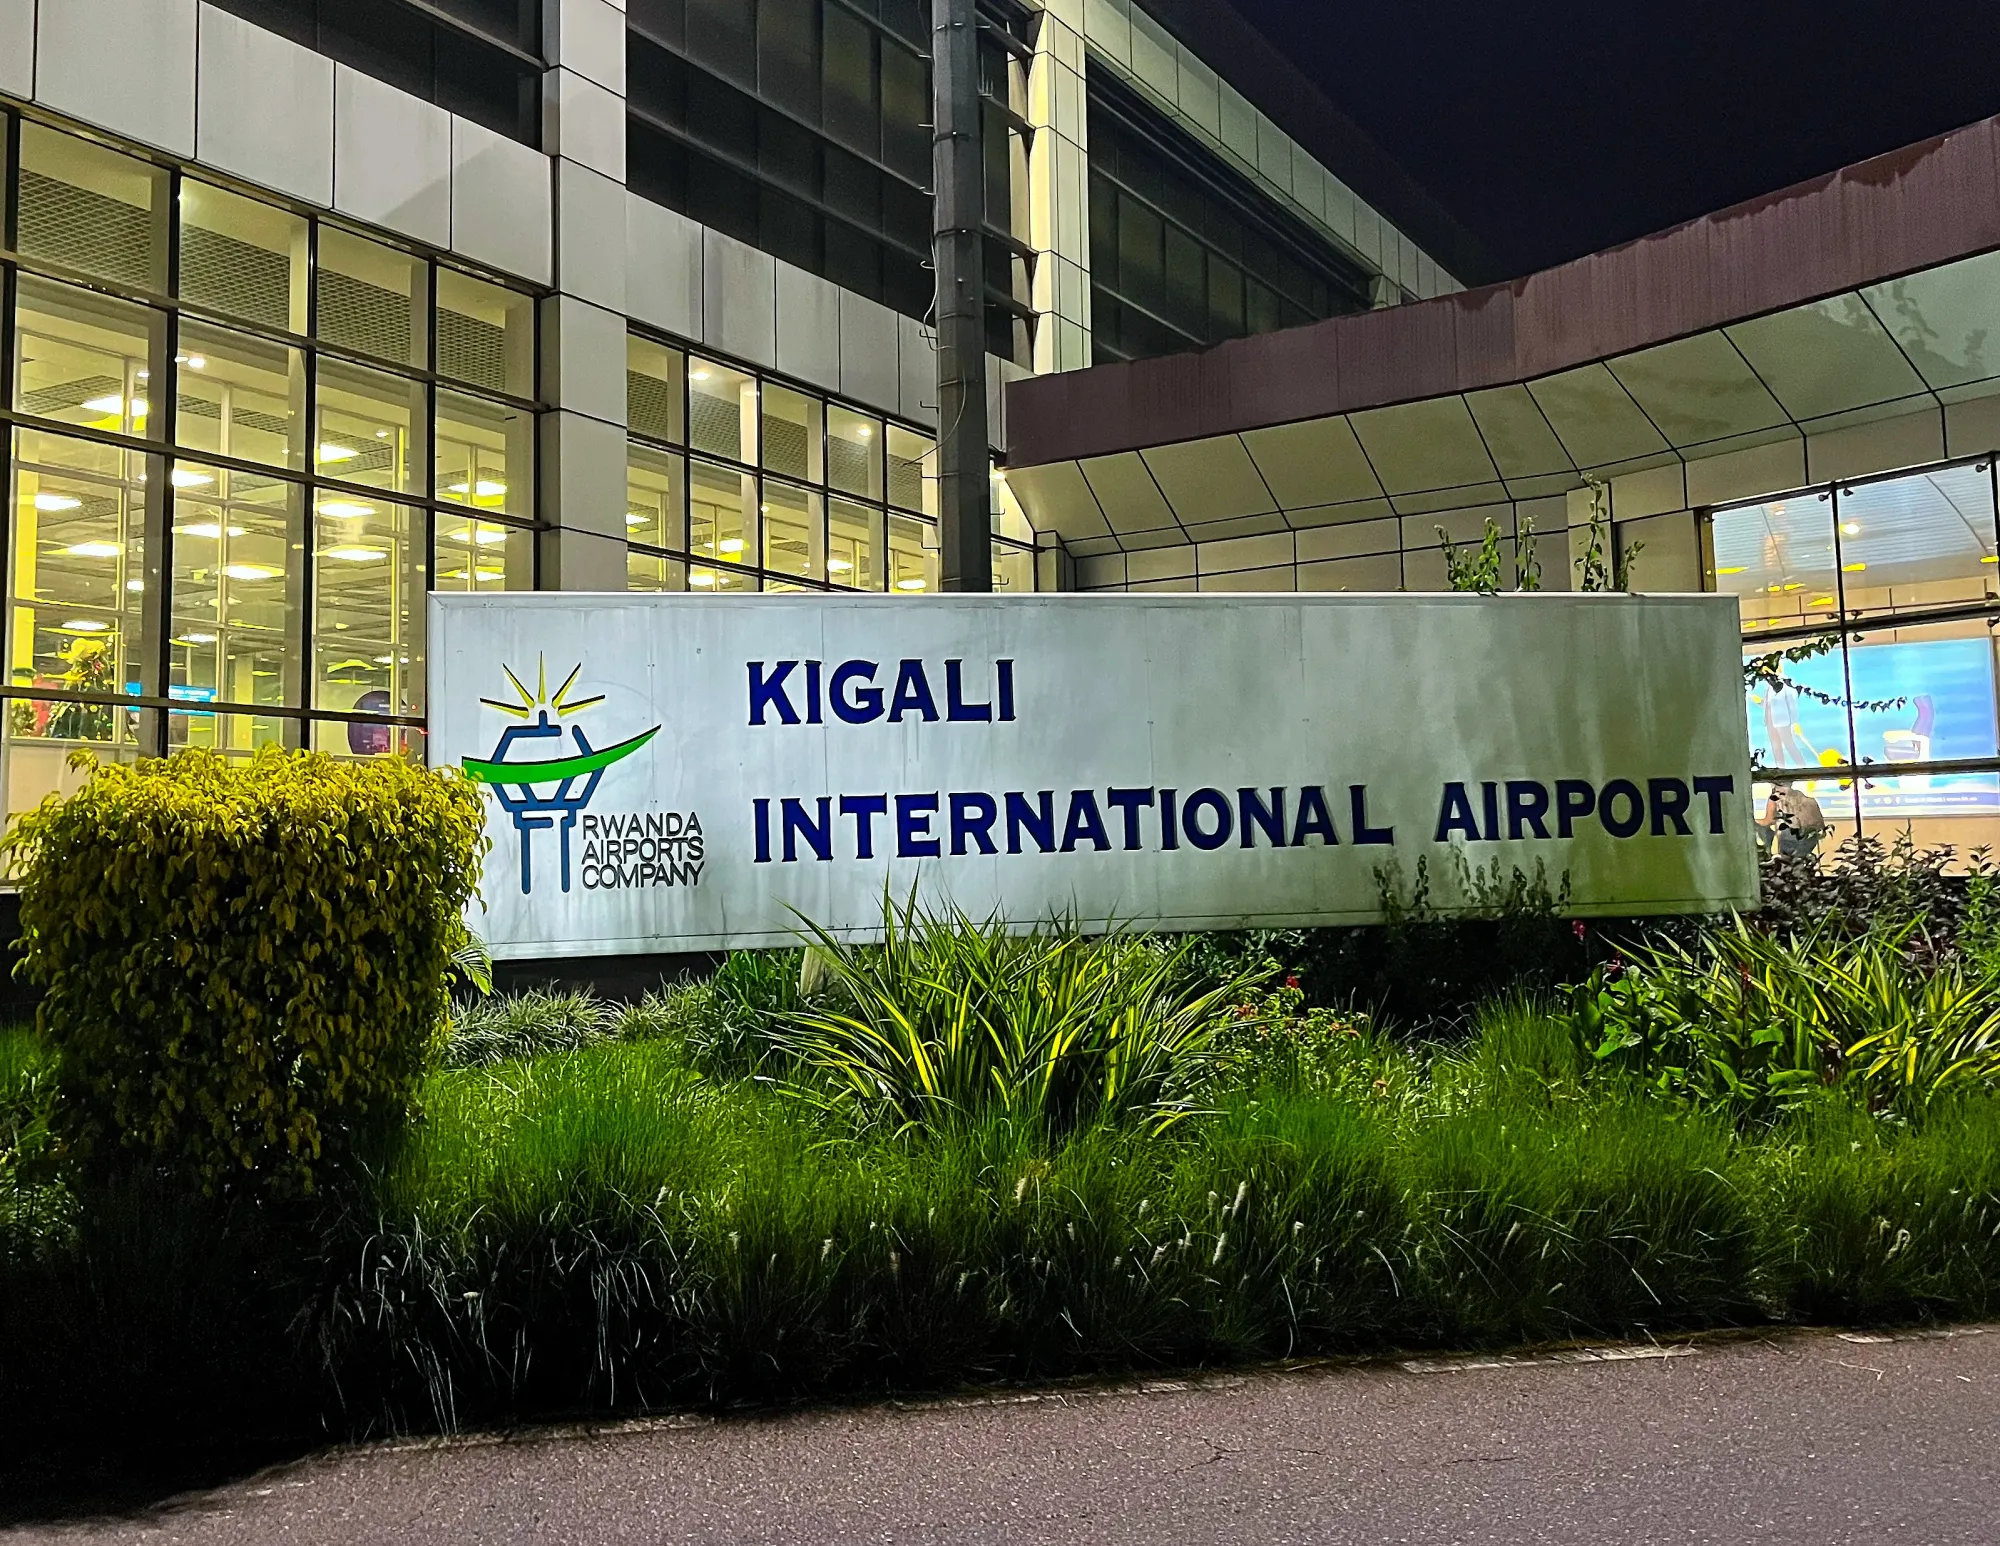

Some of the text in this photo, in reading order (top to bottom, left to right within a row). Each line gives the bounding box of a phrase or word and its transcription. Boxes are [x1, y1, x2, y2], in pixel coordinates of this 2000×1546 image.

[747, 659, 1016, 725] KIGALI
[582, 812, 702, 839] RWANDA
[752, 774, 1734, 862] INTERNATIONAL AIRPORT
[582, 836, 704, 863] AIRPORTS
[582, 861, 704, 889] COMPANY
